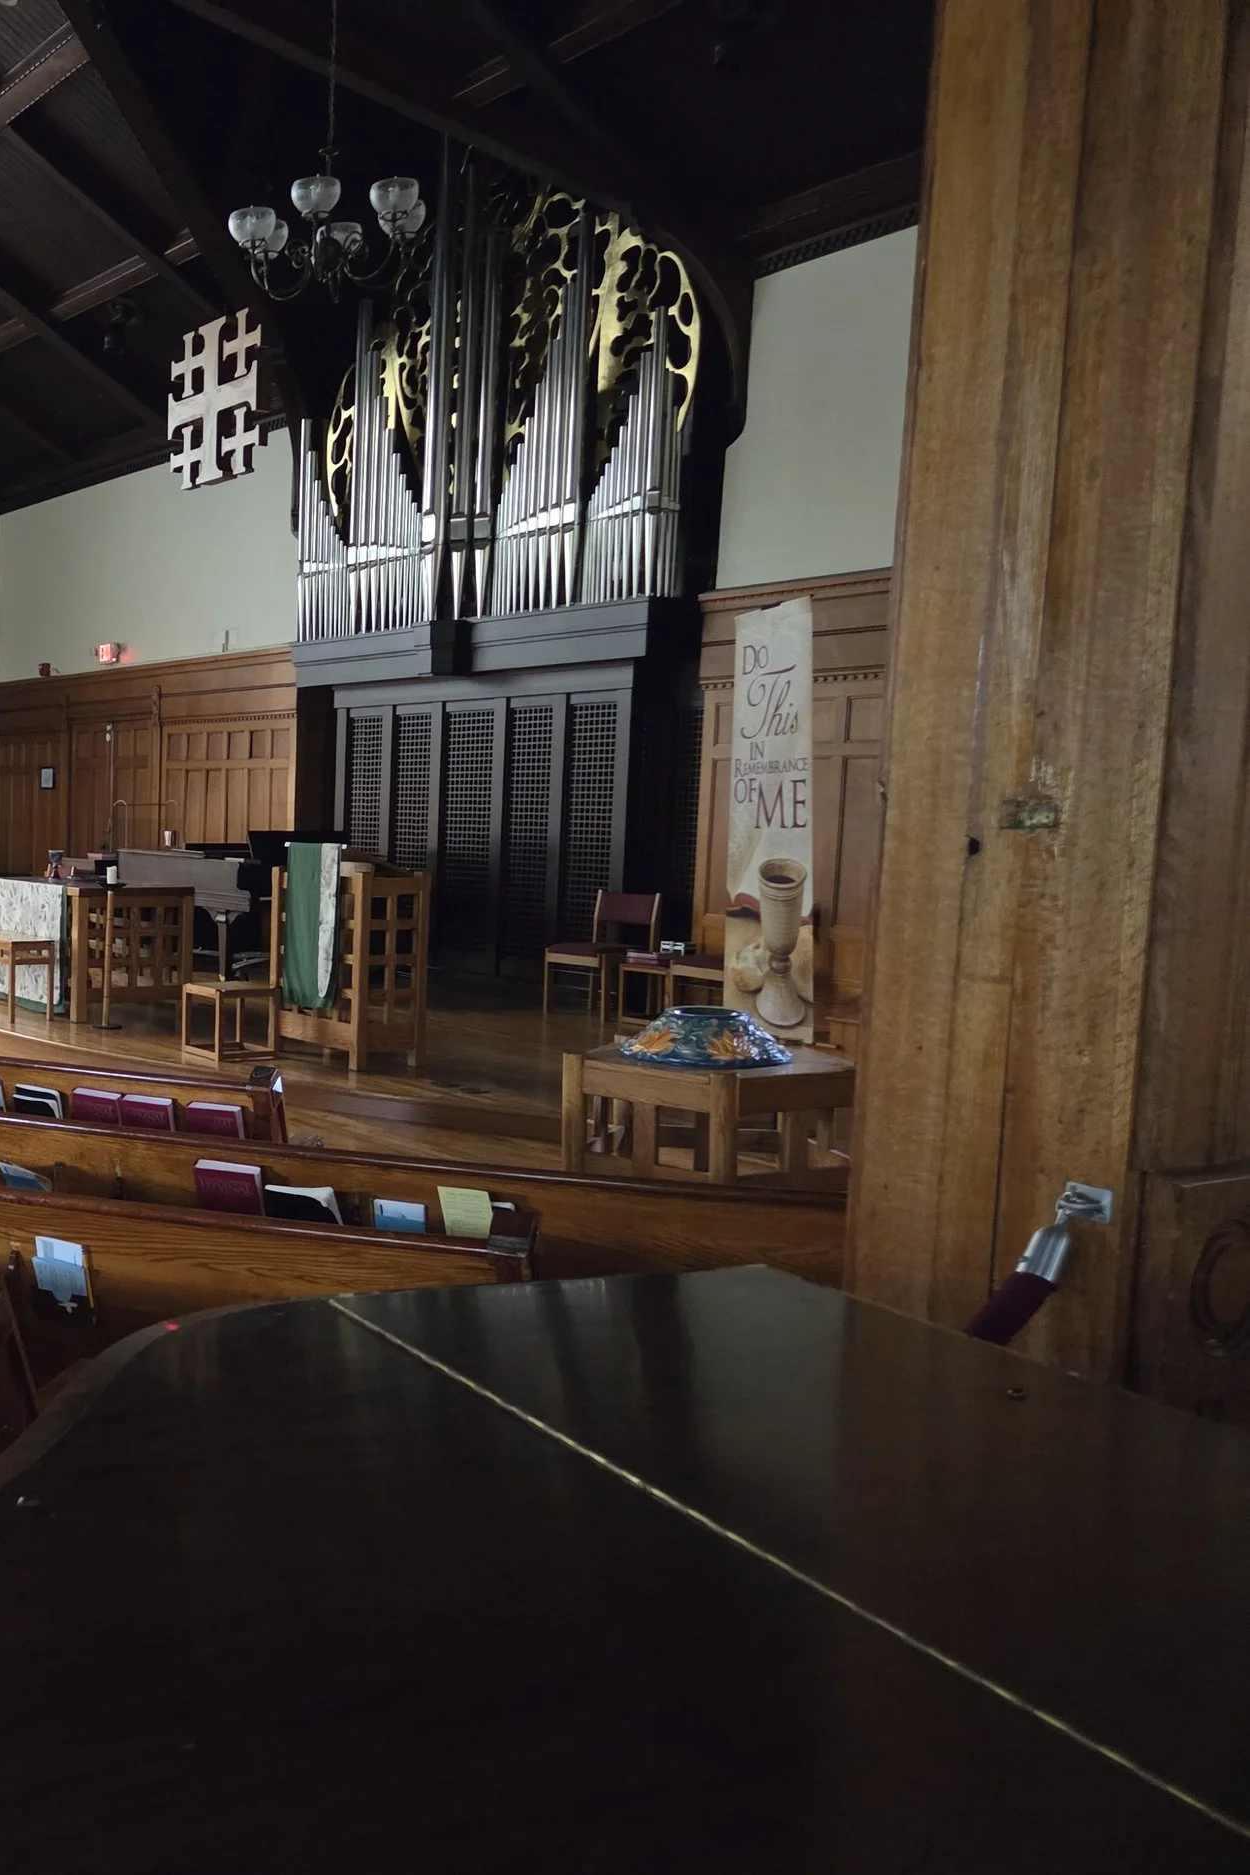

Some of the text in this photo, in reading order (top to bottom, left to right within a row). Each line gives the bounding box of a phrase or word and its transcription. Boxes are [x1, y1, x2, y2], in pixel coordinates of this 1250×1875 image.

[741, 665, 800, 739] This
[734, 757, 808, 778] REMEMBRANCE
[750, 741, 765, 761] IN
[734, 778, 807, 829] OF ME
